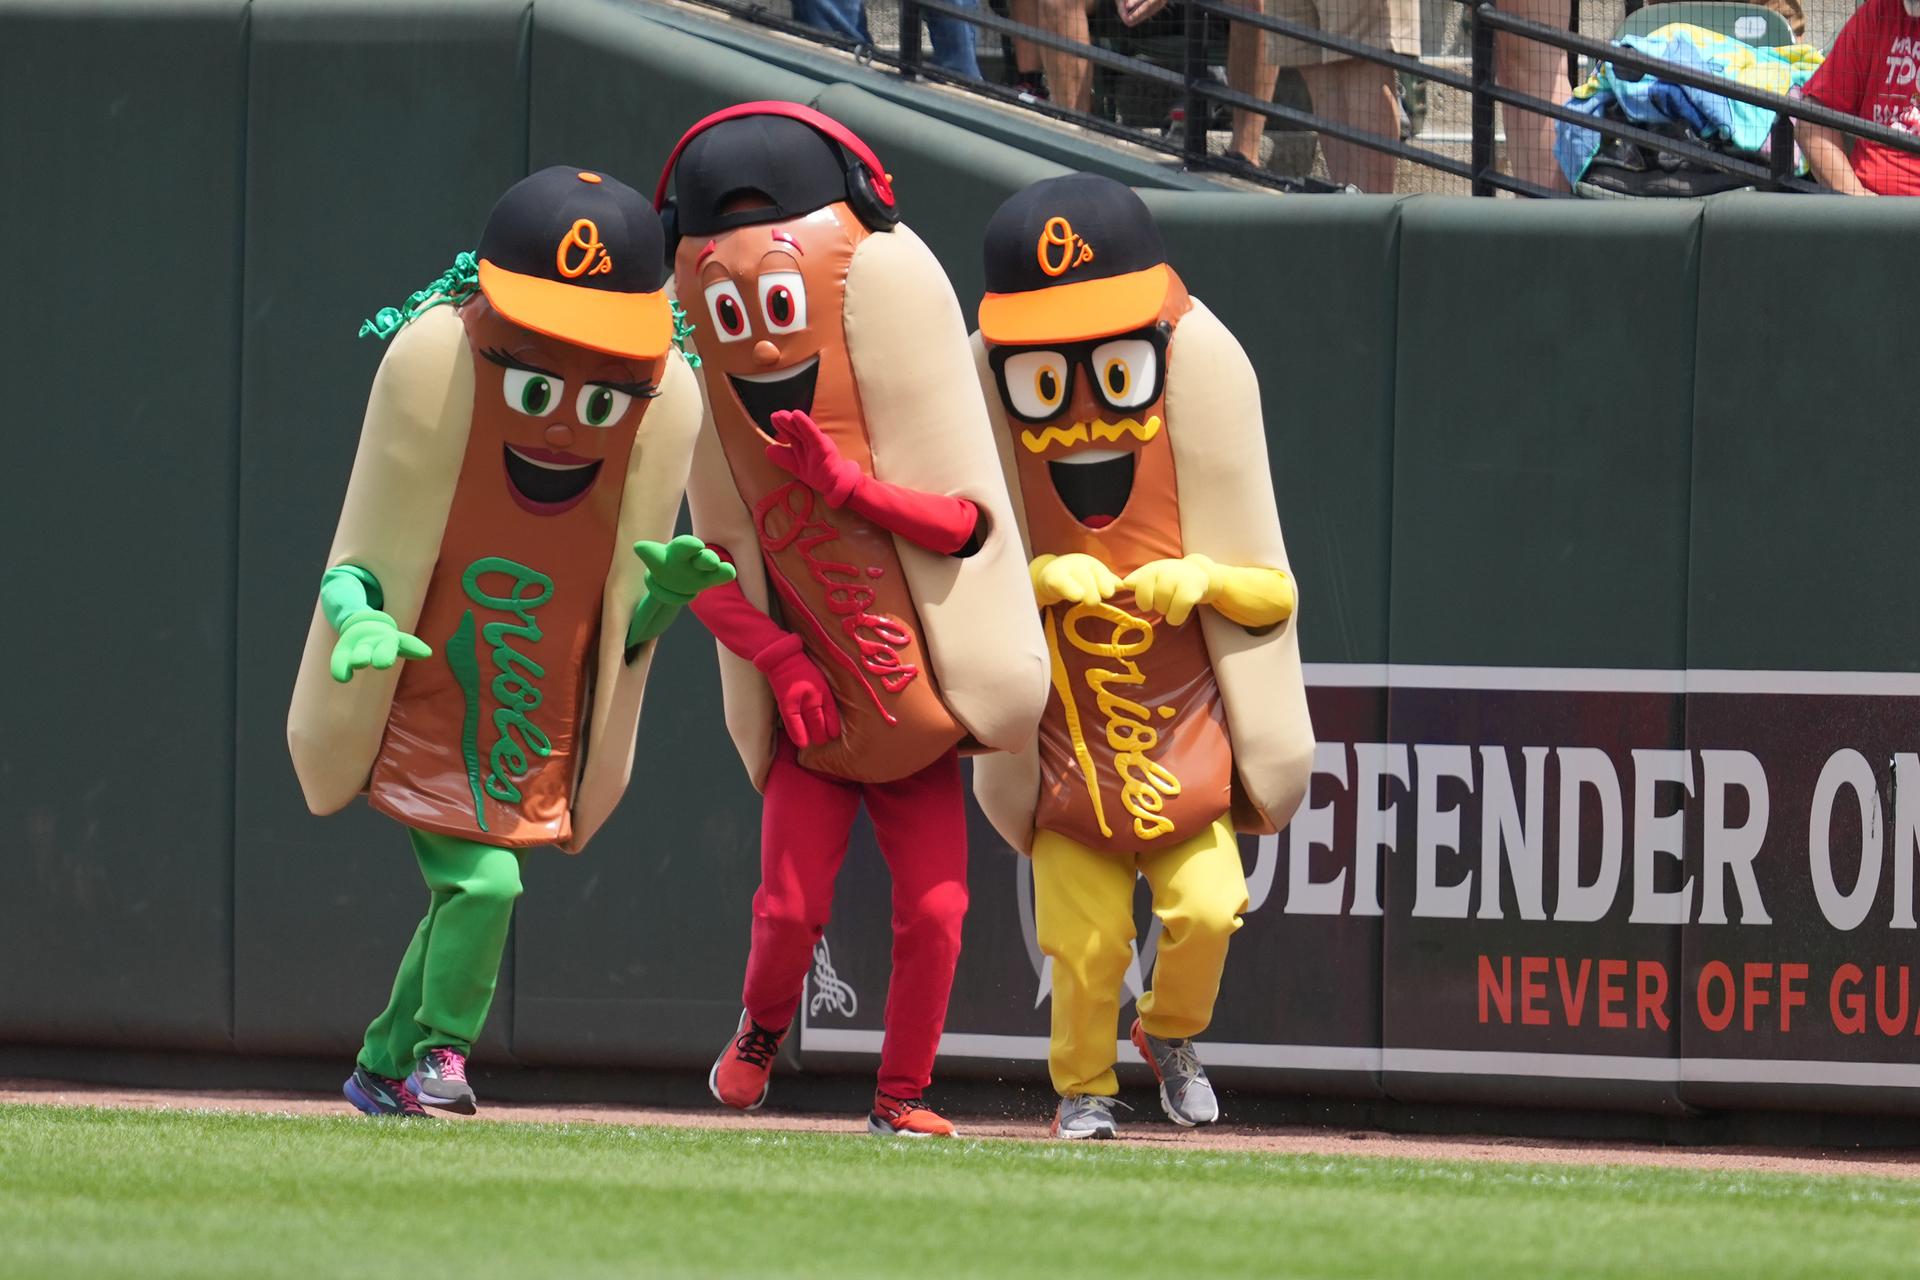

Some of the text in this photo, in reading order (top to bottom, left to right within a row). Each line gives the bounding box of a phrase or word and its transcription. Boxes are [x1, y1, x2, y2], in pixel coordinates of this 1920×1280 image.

[461, 556, 555, 804] Orioles
[754, 480, 918, 693] Orioles
[1062, 601, 1182, 841] Orioles
[1477, 954, 1920, 1036] NEVER OFF GU
